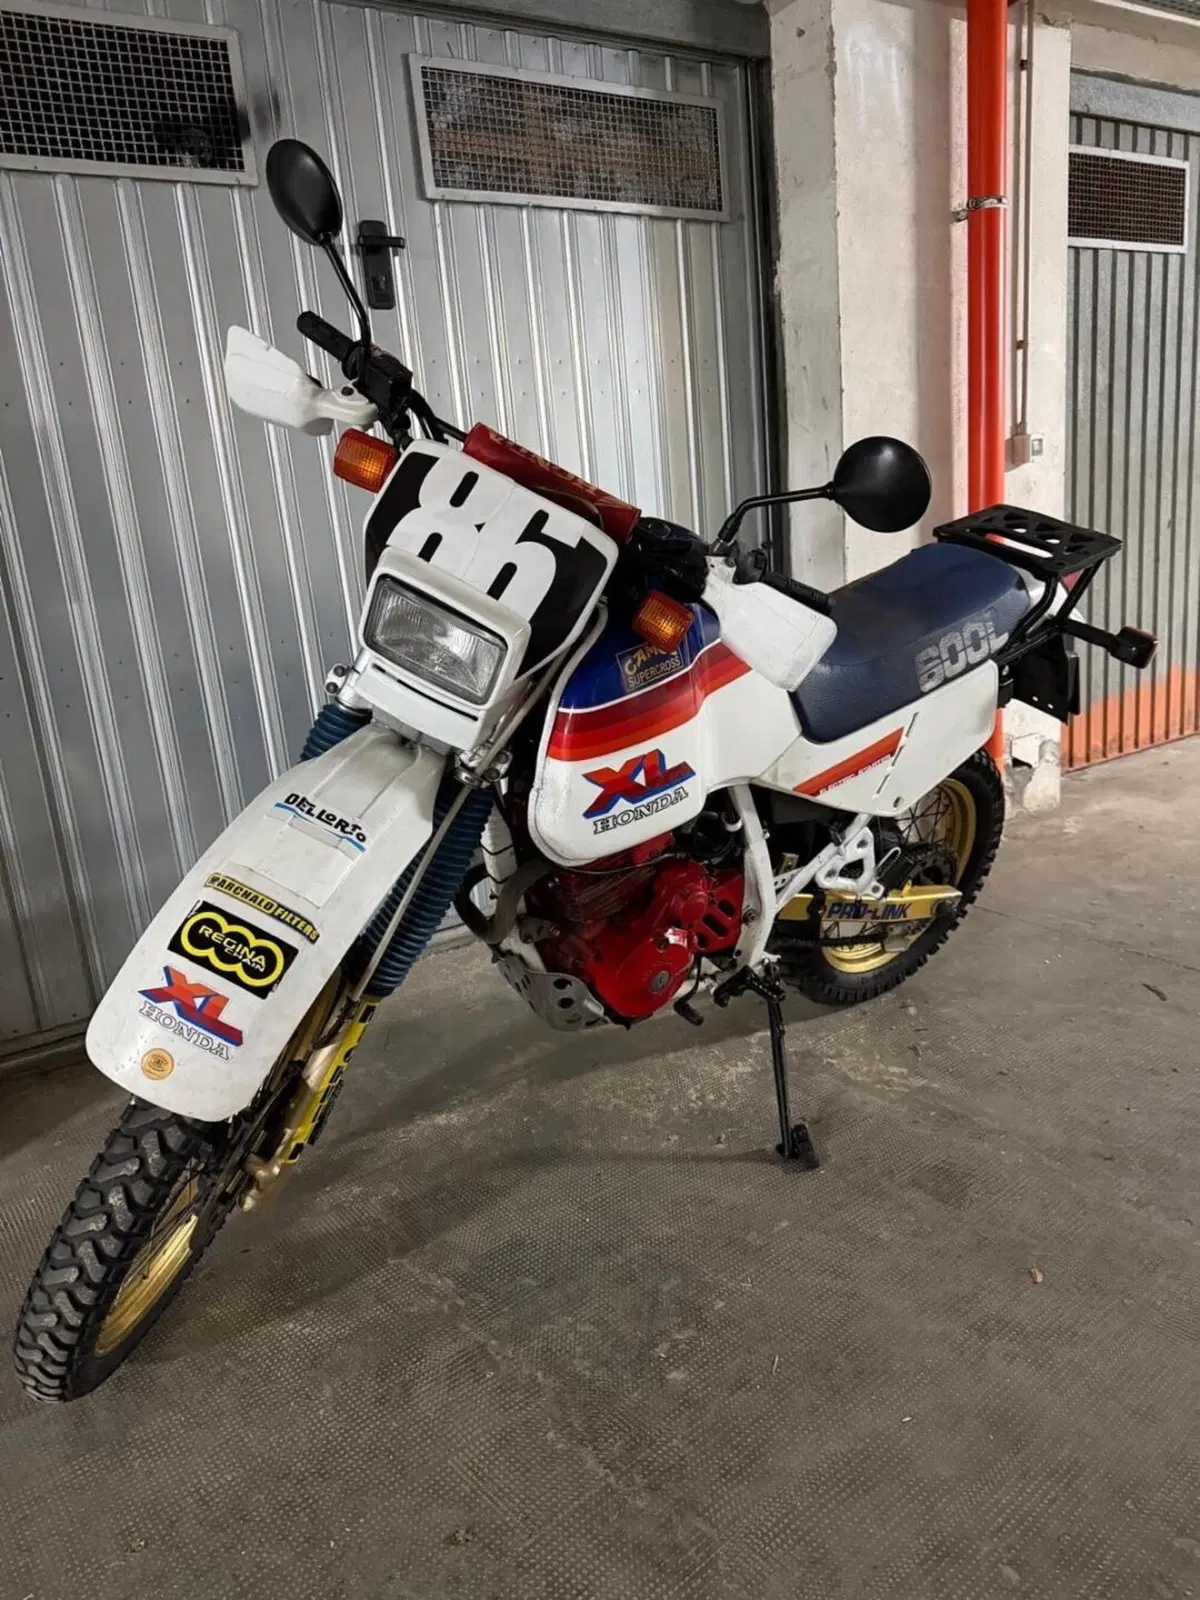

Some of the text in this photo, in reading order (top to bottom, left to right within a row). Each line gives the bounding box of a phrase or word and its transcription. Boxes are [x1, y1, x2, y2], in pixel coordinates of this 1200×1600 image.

[628, 656, 681, 688] SUPERCROSS
[582, 748, 696, 819] XL
[593, 786, 689, 835] HONDA
[198, 925, 266, 966] REGINA
[274, 906, 319, 941] FILTERS
[138, 965, 243, 1047] XL
[139, 1000, 232, 1060] HONDA
